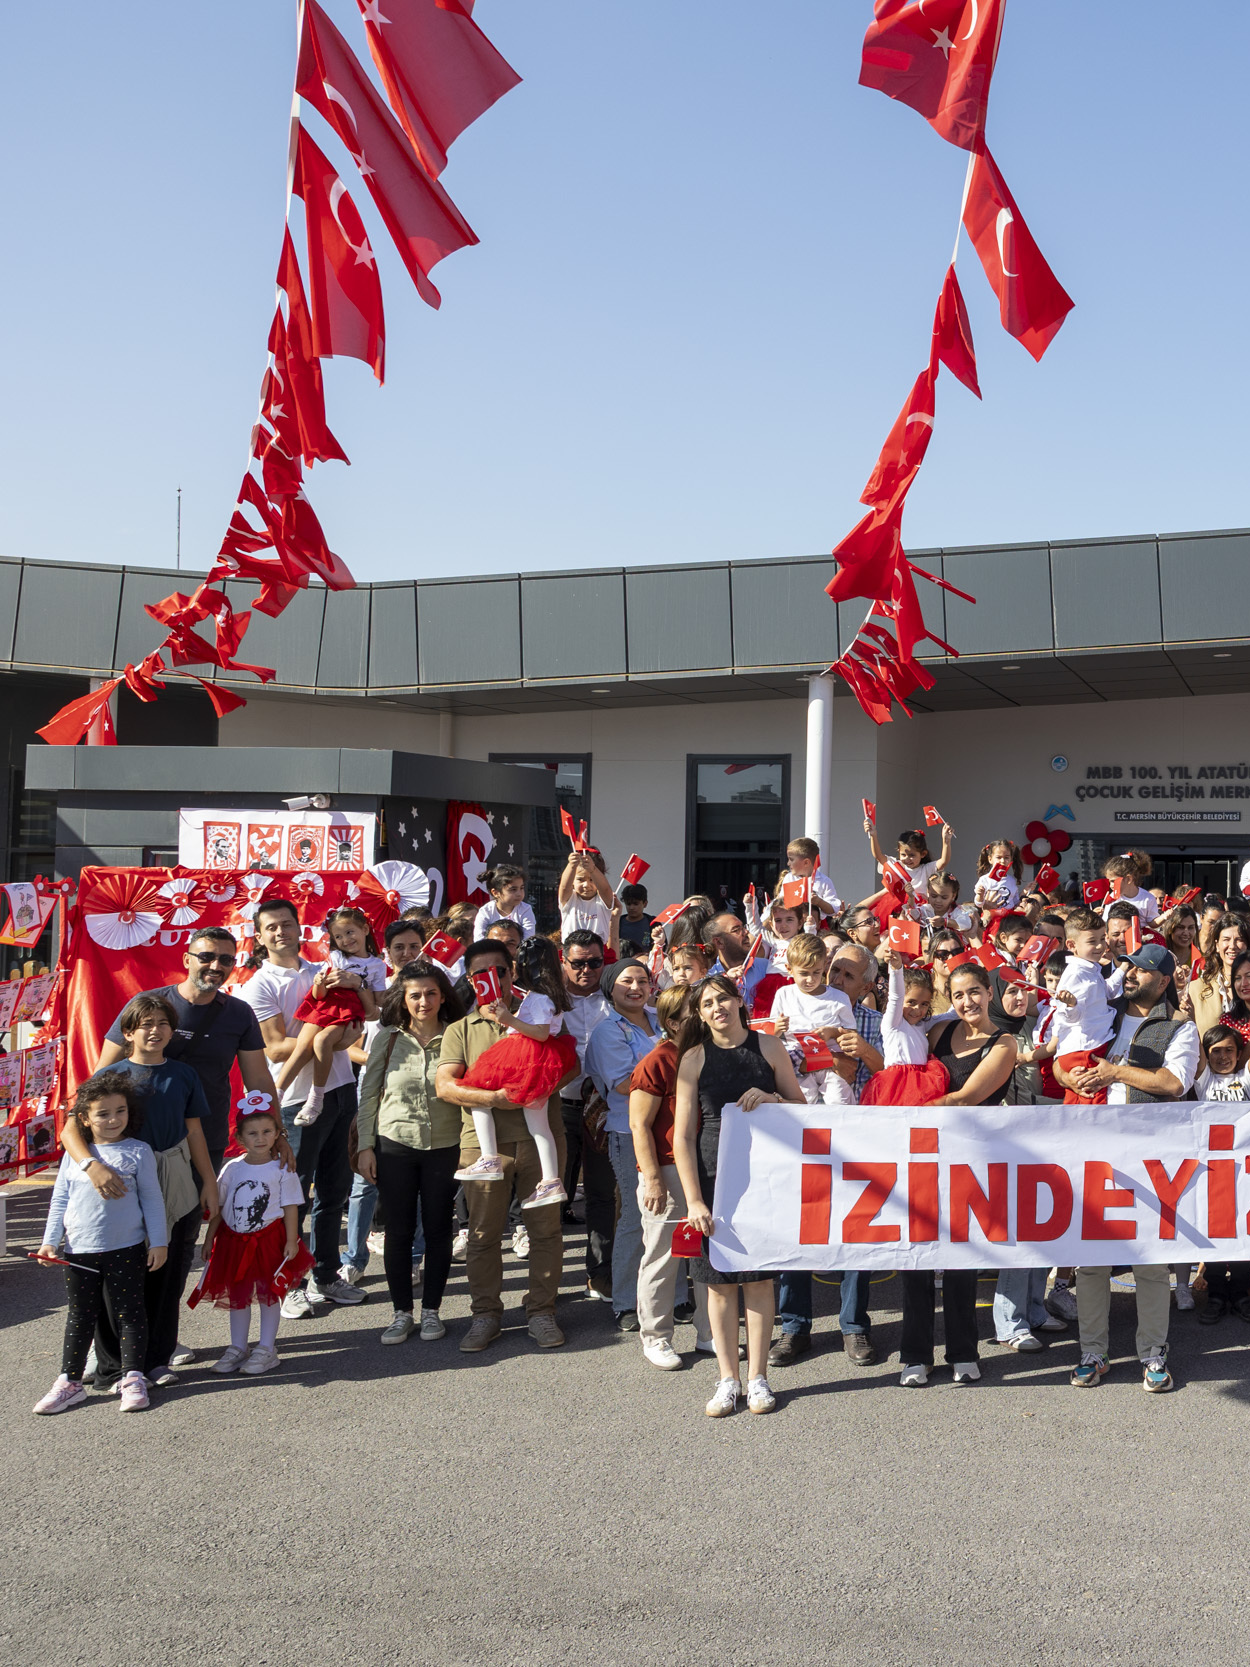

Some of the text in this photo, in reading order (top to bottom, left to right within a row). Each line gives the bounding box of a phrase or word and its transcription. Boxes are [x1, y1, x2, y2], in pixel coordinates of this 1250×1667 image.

[1086, 766, 1123, 779] MBB
[1130, 766, 1162, 779] 100.
[1167, 766, 1192, 779] YIL
[1075, 784, 1134, 802] ÇOCUK
[1138, 782, 1205, 802] GELİŞİM
[1129, 812, 1156, 820] MERSİN
[1157, 812, 1202, 821] BÜYÜKŞEHİR
[1203, 812, 1240, 820] BELEDİYESİ
